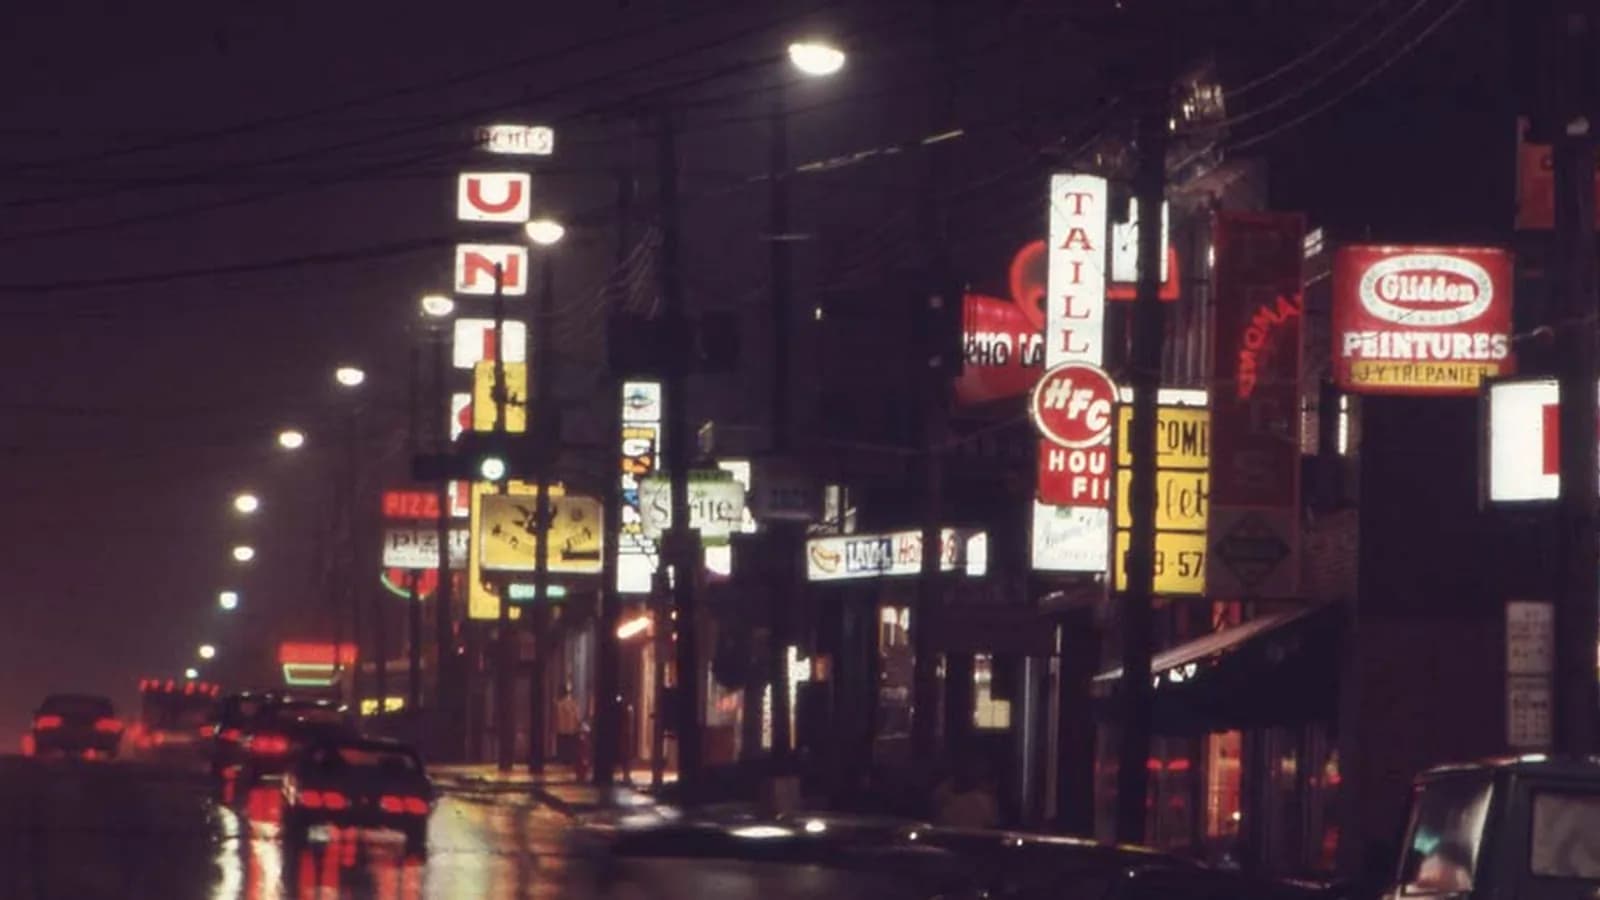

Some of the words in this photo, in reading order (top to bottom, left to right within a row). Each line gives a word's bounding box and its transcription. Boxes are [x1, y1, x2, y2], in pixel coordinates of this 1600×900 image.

[1381, 273, 1475, 302] Glidden
[1342, 330, 1509, 360] PEINTURES
[1043, 378, 1112, 431] HFC
